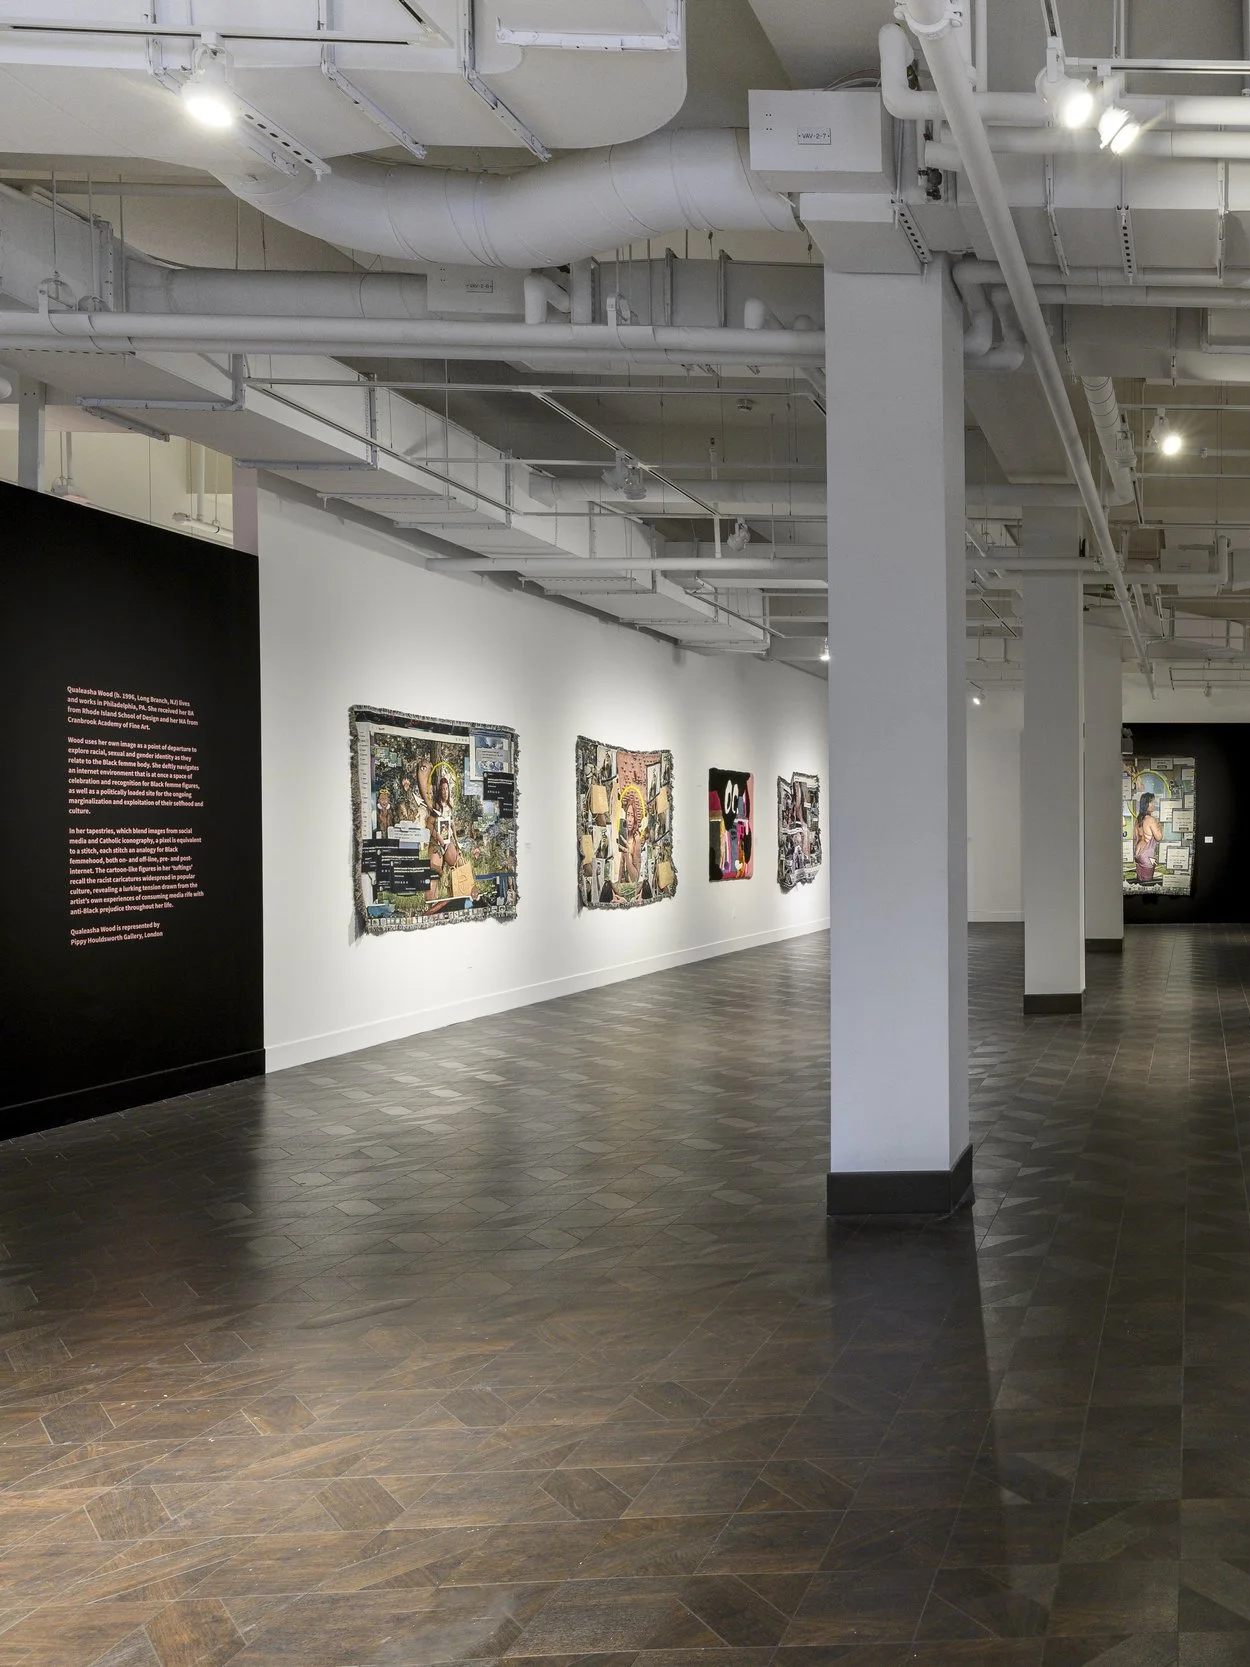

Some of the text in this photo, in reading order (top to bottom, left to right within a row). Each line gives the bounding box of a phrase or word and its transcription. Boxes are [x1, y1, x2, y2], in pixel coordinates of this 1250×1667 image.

[67, 686, 98, 696] Qualeasha
[98, 690, 114, 698] Wood
[137, 695, 150, 704] Long
[150, 696, 170, 705] Branch,
[68, 717, 97, 725] Cranbrook
[98, 720, 122, 729] Academy
[90, 749, 108, 757] racial,
[154, 753, 174, 762] identity
[112, 780, 142, 788] recognition
[70, 927, 100, 937] Qualeasha
[122, 922, 153, 932] represented
[88, 934, 123, 944] Houldsworth
